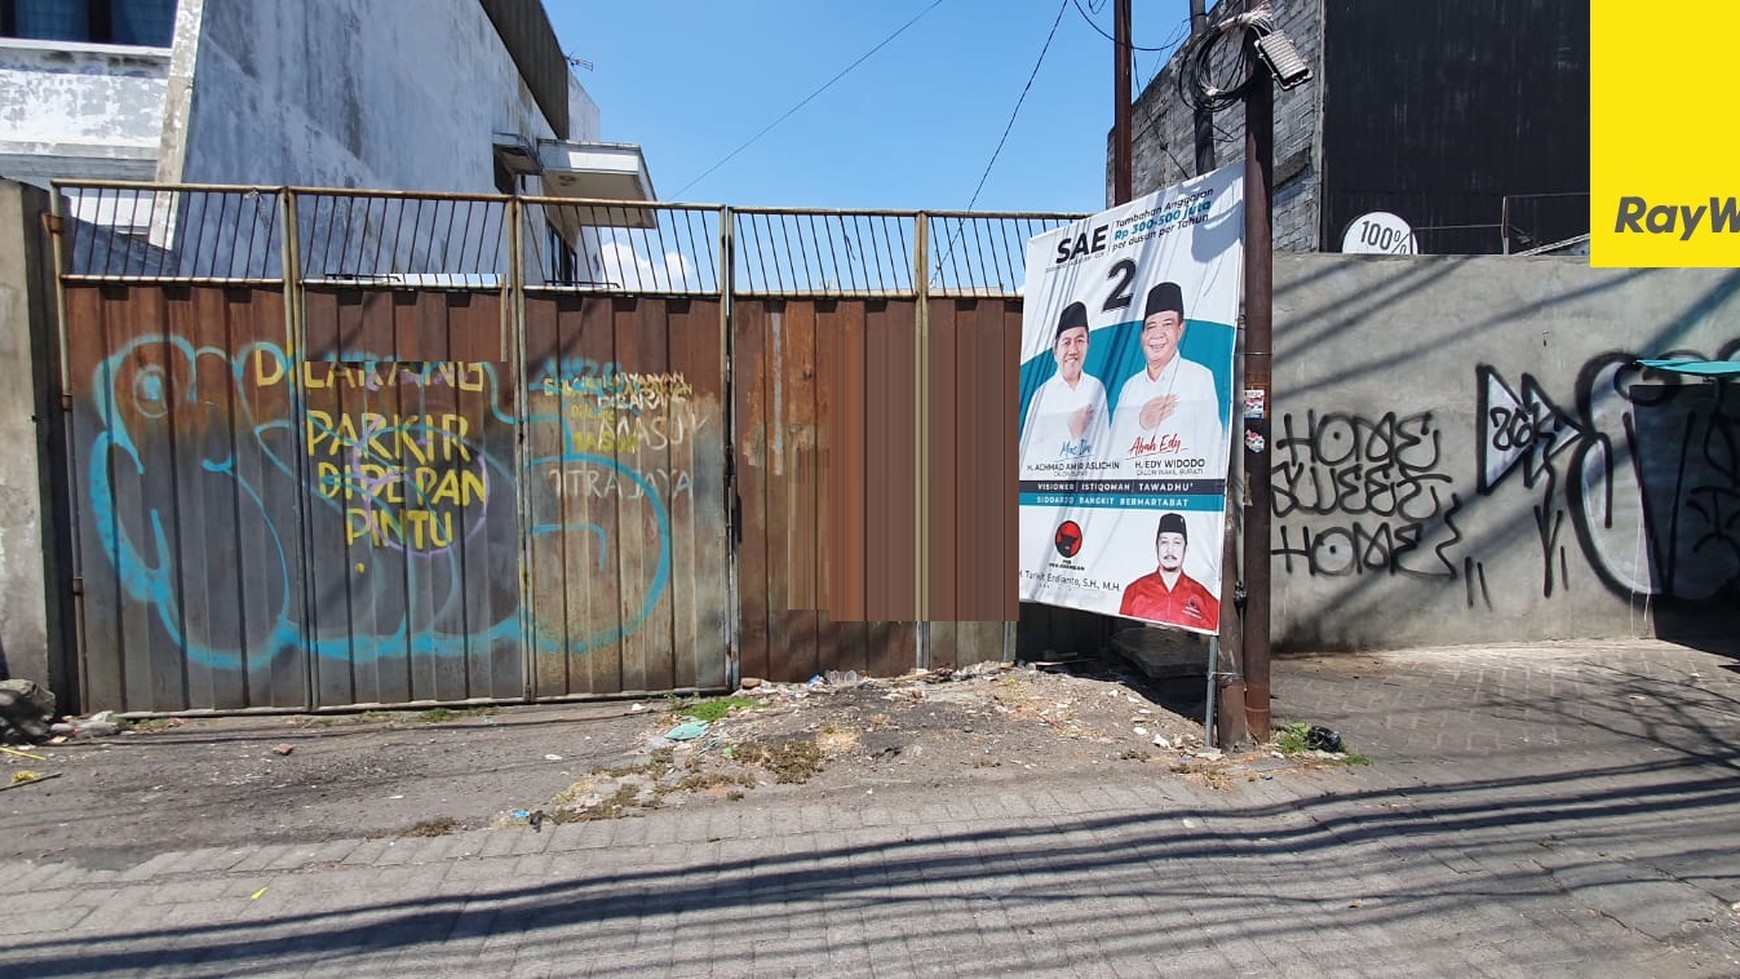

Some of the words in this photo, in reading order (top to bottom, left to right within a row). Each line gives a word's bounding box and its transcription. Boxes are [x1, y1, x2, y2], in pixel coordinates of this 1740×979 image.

[1114, 206, 1163, 228] Tambahan
[1165, 187, 1214, 211] Anggaran
[1055, 224, 1109, 264] SAE
[1112, 241, 1127, 252] per
[1128, 232, 1157, 246] dusun
[1158, 225, 1175, 239] per
[1177, 213, 1209, 231] Tahun
[1114, 230, 1129, 242] Rp
[1360, 219, 1410, 254] 100%
[1102, 256, 1137, 313] 2
[306, 410, 471, 464] PARKIR
[1159, 433, 1182, 454] Edy
[1276, 409, 1440, 472] HOME
[1065, 462, 1084, 471] AMIR
[1144, 460, 1162, 469] EDY
[1164, 458, 1206, 469] WIDODO
[1037, 483, 1075, 491] VISIONER
[1081, 484, 1130, 492] ISTIQOMAH
[1079, 497, 1114, 505] BANGKIT
[1119, 498, 1190, 507] BERMARTABAT
[346, 508, 454, 549] PINTU
[1271, 520, 1455, 580] HOME
